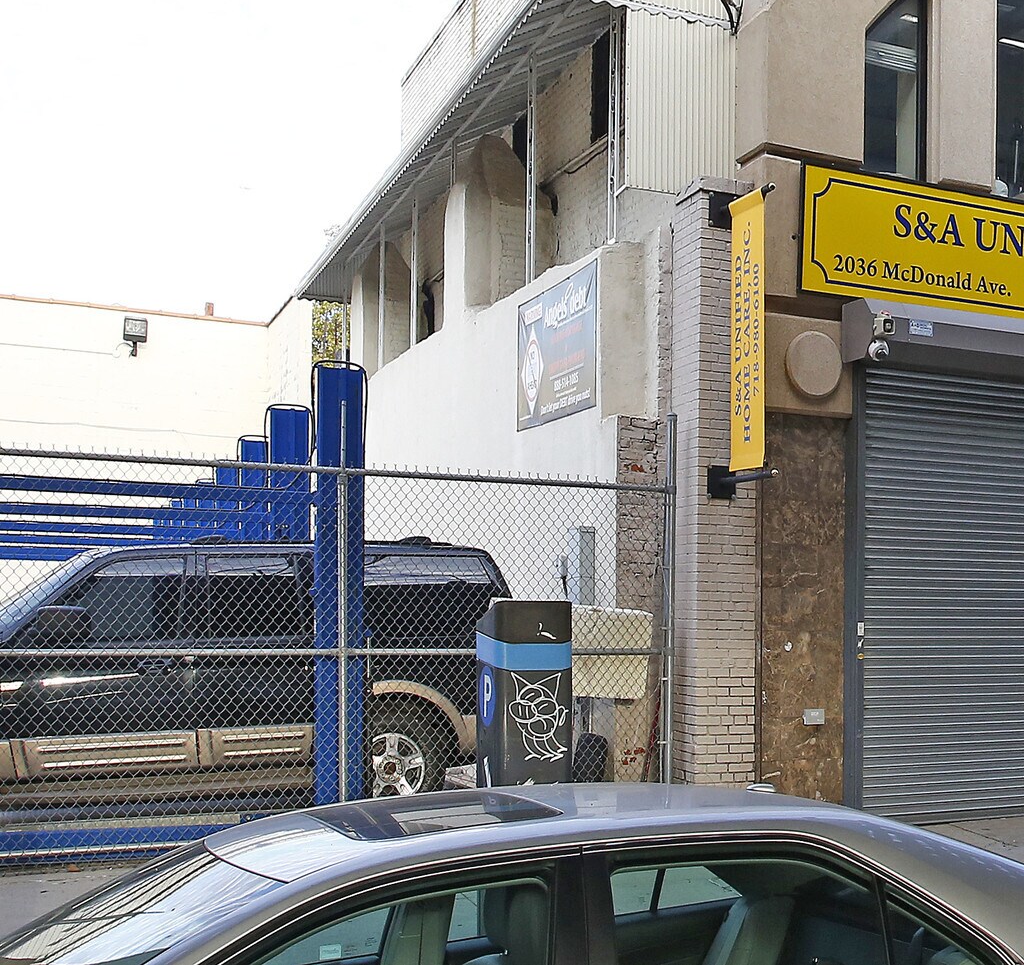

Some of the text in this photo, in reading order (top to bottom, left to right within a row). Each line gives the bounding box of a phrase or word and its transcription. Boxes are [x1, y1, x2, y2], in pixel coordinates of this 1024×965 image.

[893, 204, 965, 247] S&A
[833, 254, 1012, 297] 2036 McDonald Ave.
[743, 221, 752, 443] HOME CARE, INC.
